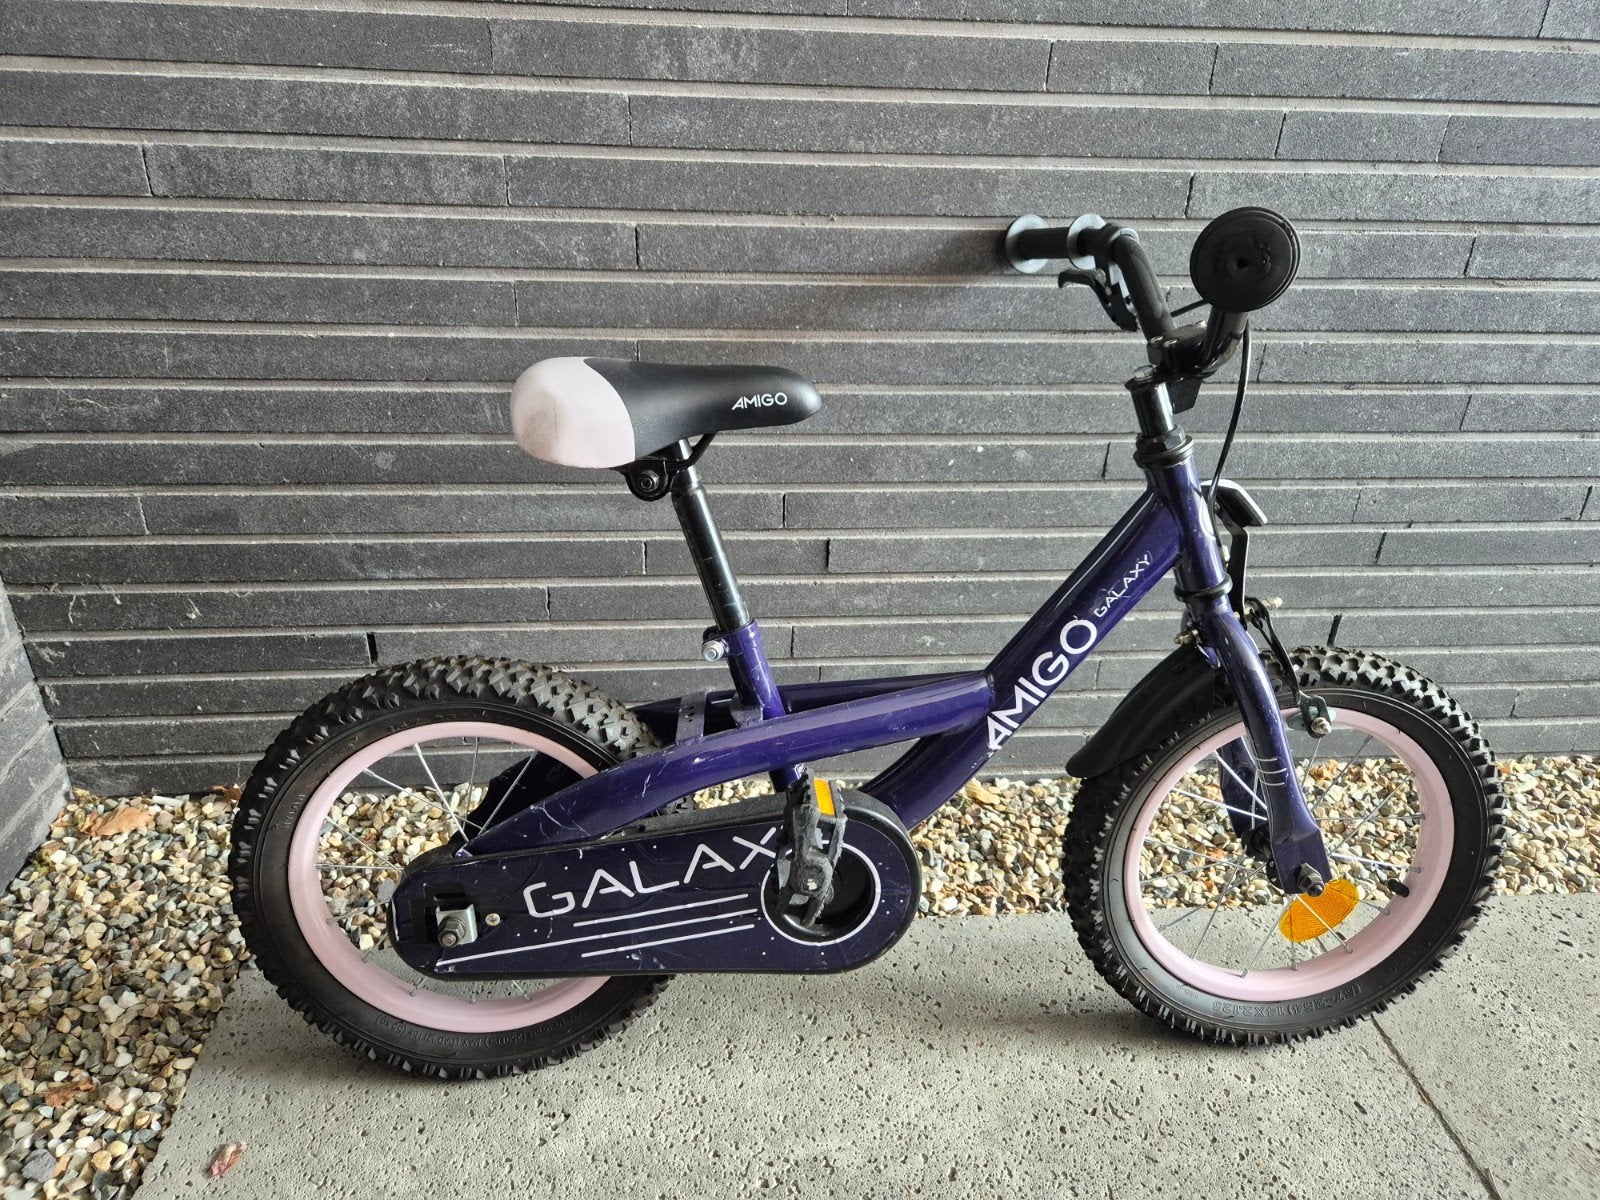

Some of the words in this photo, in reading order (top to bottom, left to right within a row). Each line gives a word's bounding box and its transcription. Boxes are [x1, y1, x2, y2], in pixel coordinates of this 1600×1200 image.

[731, 391, 788, 411] AMIGO
[987, 619, 1097, 750] AMIGO
[1093, 553, 1151, 618] GALAXY
[523, 826, 784, 918] GALAX
